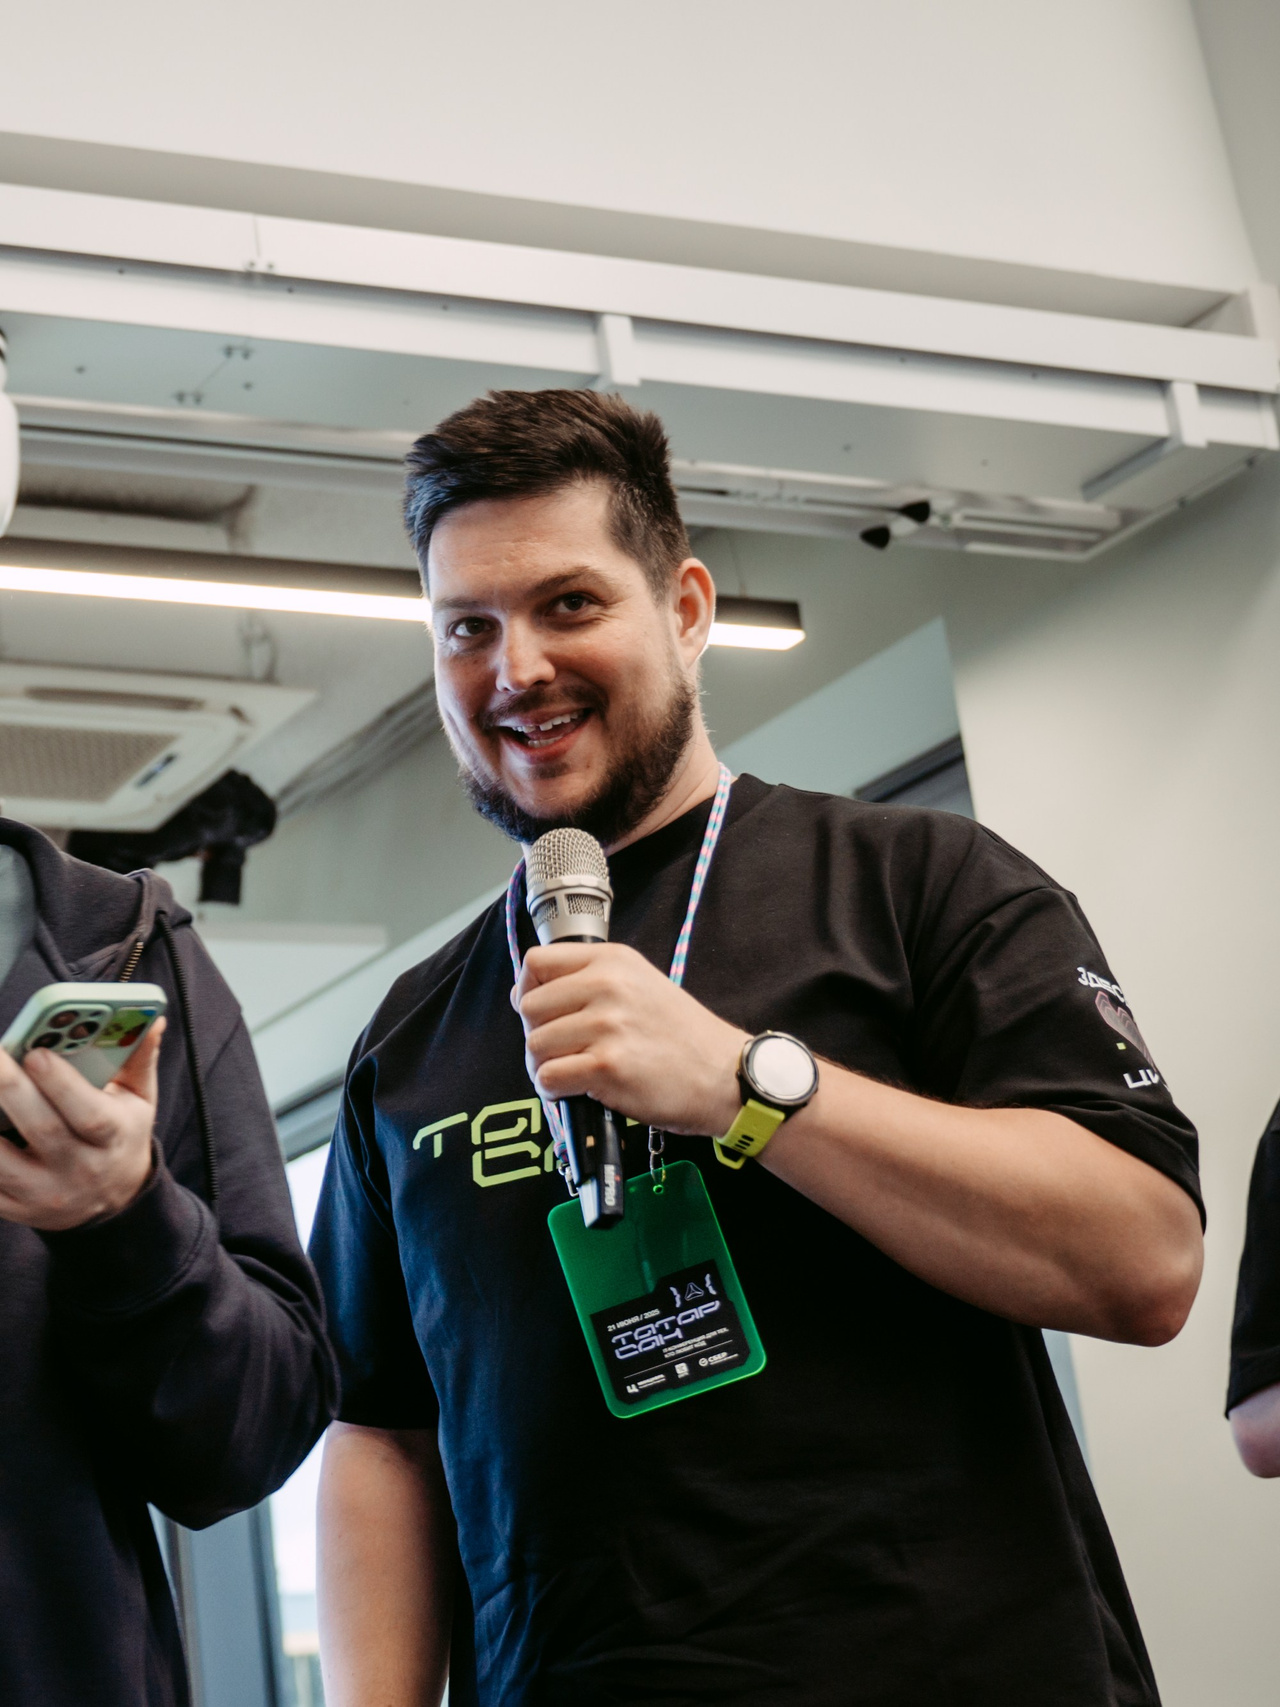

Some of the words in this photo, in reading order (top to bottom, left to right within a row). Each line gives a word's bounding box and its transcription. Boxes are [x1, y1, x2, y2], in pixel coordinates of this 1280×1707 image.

[1077, 966, 1126, 1003] ЗДЕС
[604, 1164, 616, 1206] MIPRO
[607, 1324, 616, 1332] 21
